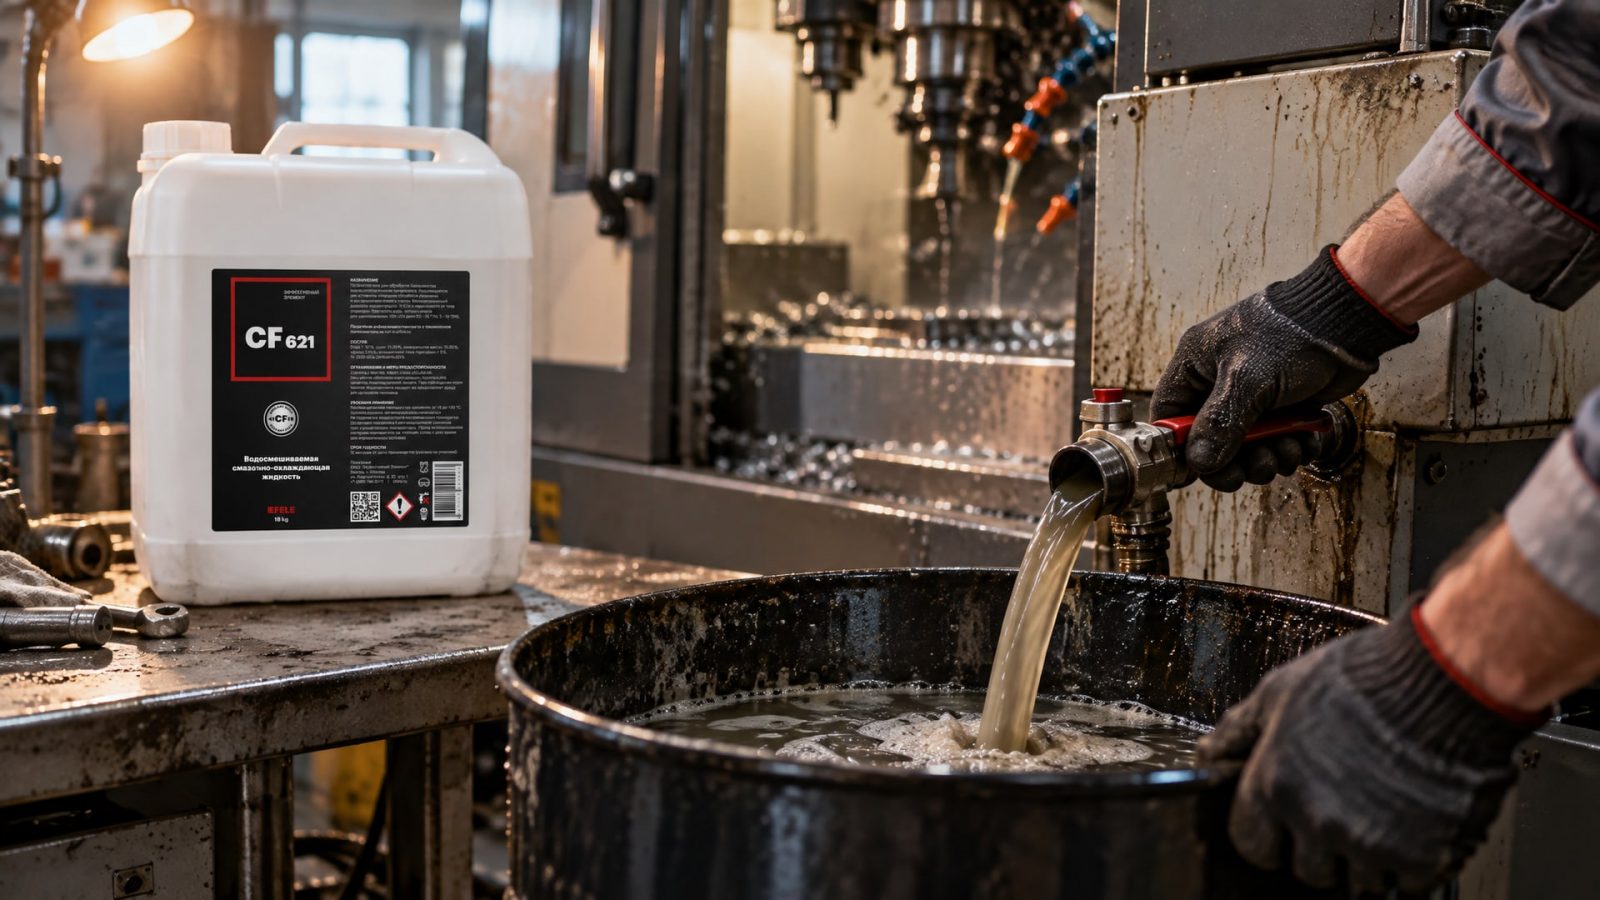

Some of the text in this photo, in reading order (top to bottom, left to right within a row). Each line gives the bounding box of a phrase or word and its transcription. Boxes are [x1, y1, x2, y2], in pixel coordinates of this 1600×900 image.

[245, 326, 315, 349] CF 621
[244, 455, 319, 463] Водосмешиваемая
